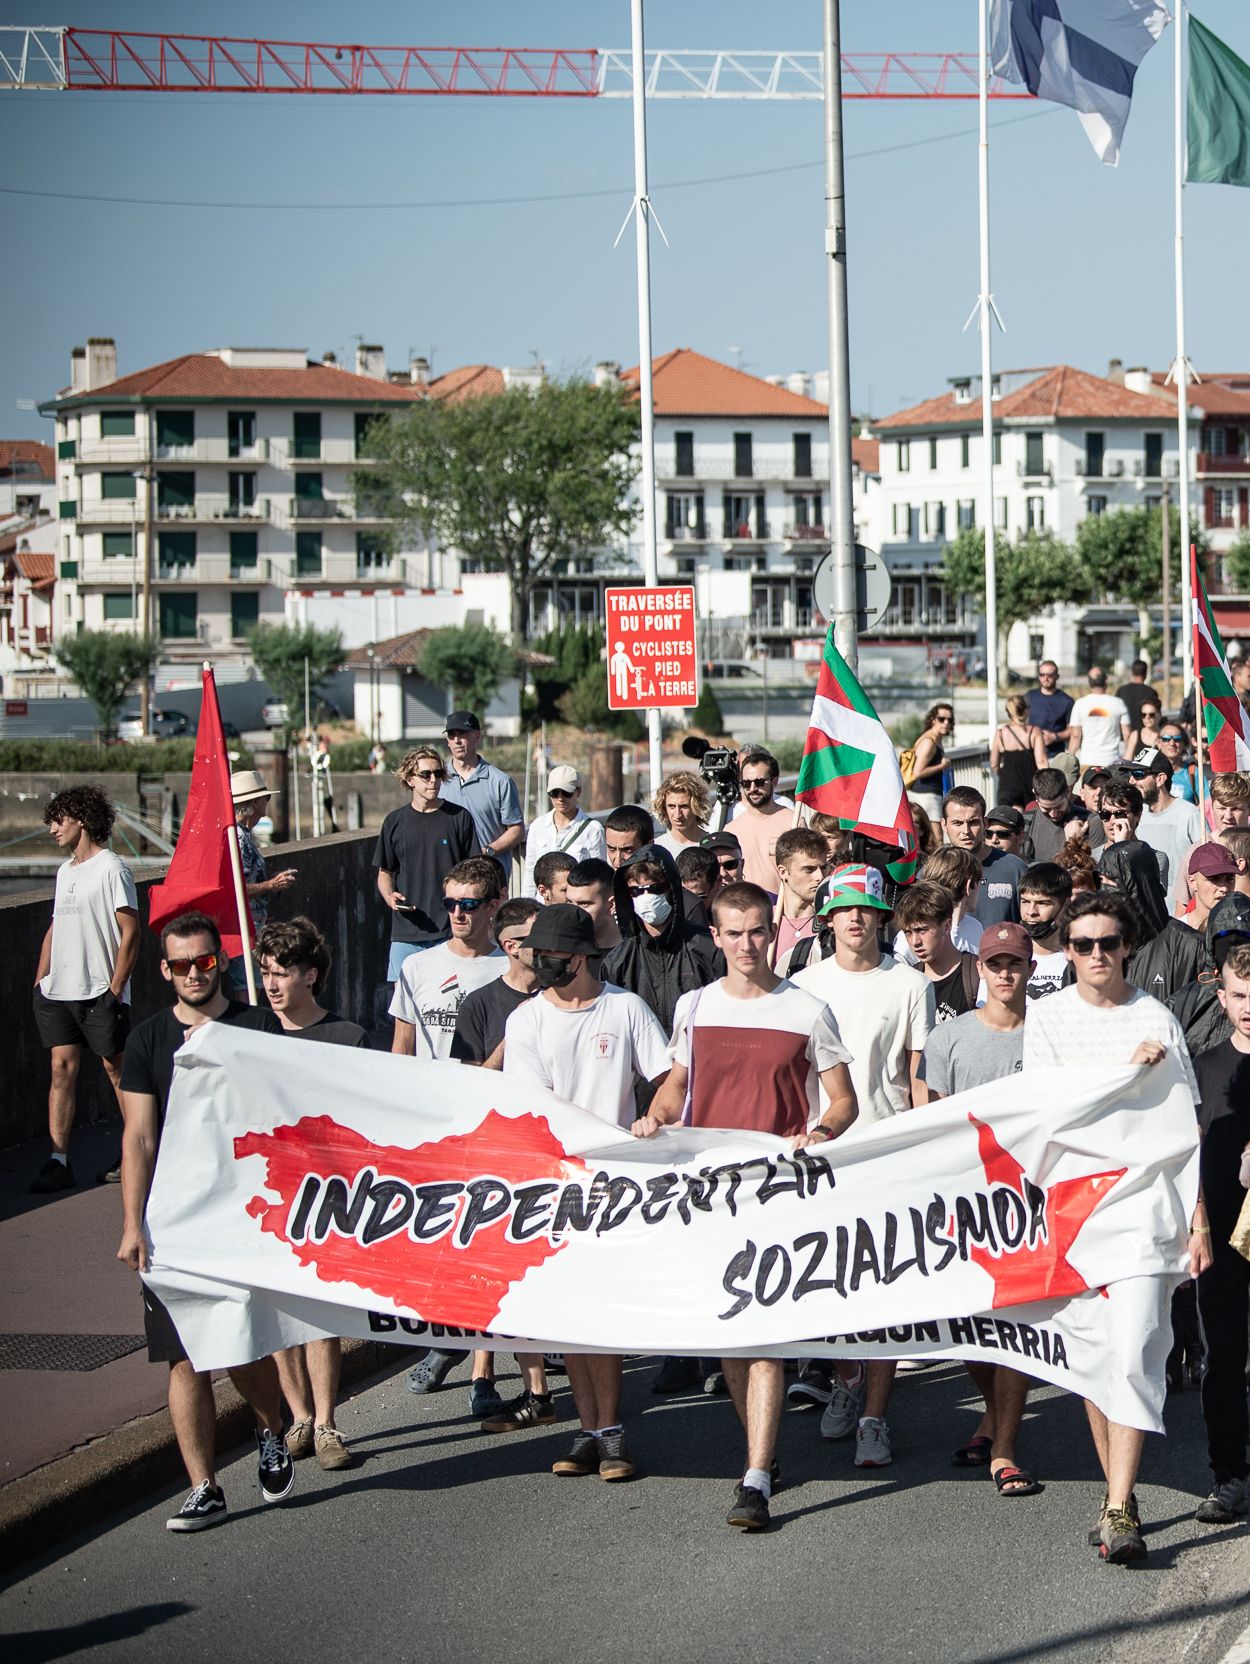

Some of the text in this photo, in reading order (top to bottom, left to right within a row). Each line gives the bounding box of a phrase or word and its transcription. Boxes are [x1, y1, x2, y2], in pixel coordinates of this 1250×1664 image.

[609, 591, 692, 611] TRAVERSÉE
[620, 614, 682, 632] DU PONT
[632, 640, 693, 657] CYCLISTES
[654, 661, 681, 676] PIED
[658, 680, 695, 696] TERRE
[291, 1147, 837, 1246] INDEPENDENTZIA
[717, 1177, 1048, 1321] SOZIALISMOA
[950, 1314, 1071, 1371] HERRIA
